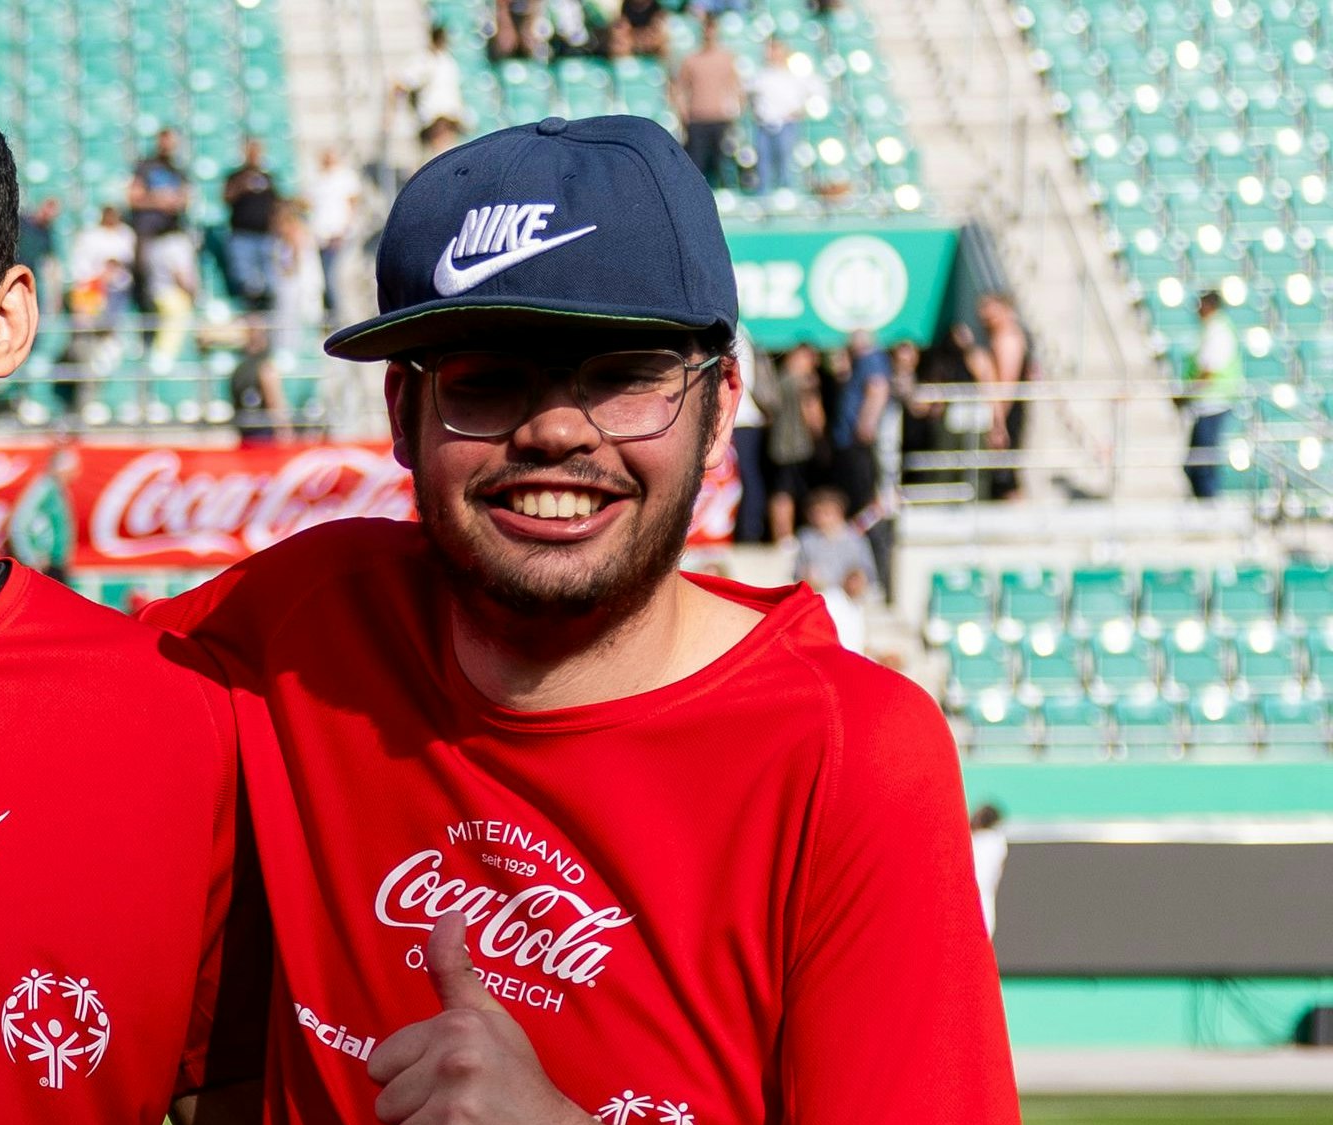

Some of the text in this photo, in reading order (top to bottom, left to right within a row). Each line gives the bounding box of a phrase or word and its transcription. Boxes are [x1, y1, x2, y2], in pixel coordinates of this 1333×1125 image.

[453, 204, 556, 259] NIKE
[447, 820, 586, 885] MITEINAND
[481, 851, 537, 878] seit 1929
[405, 943, 564, 1013] ÖREICH
[294, 1002, 376, 1062] ecial
